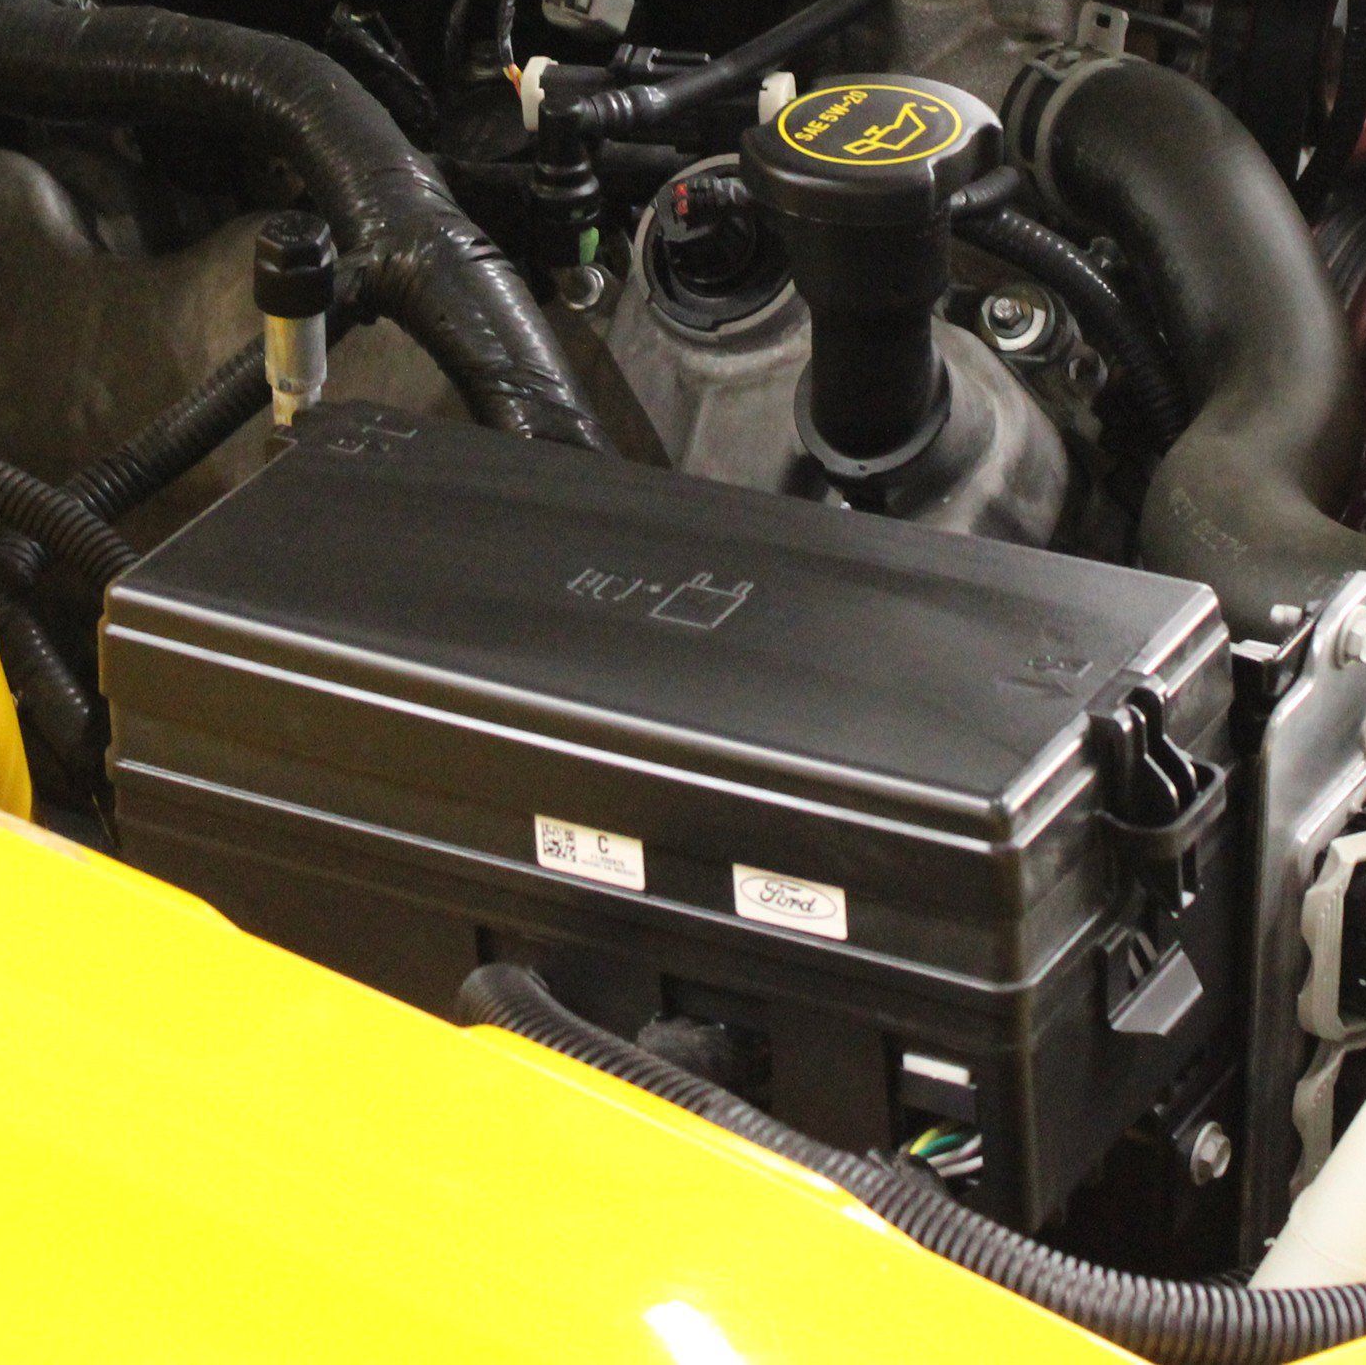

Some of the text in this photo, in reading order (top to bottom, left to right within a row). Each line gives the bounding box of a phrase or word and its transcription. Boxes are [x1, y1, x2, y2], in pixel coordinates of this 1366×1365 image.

[794, 90, 869, 142] SAE 5W-20
[598, 834, 609, 854] C
[759, 880, 817, 914] Ford
